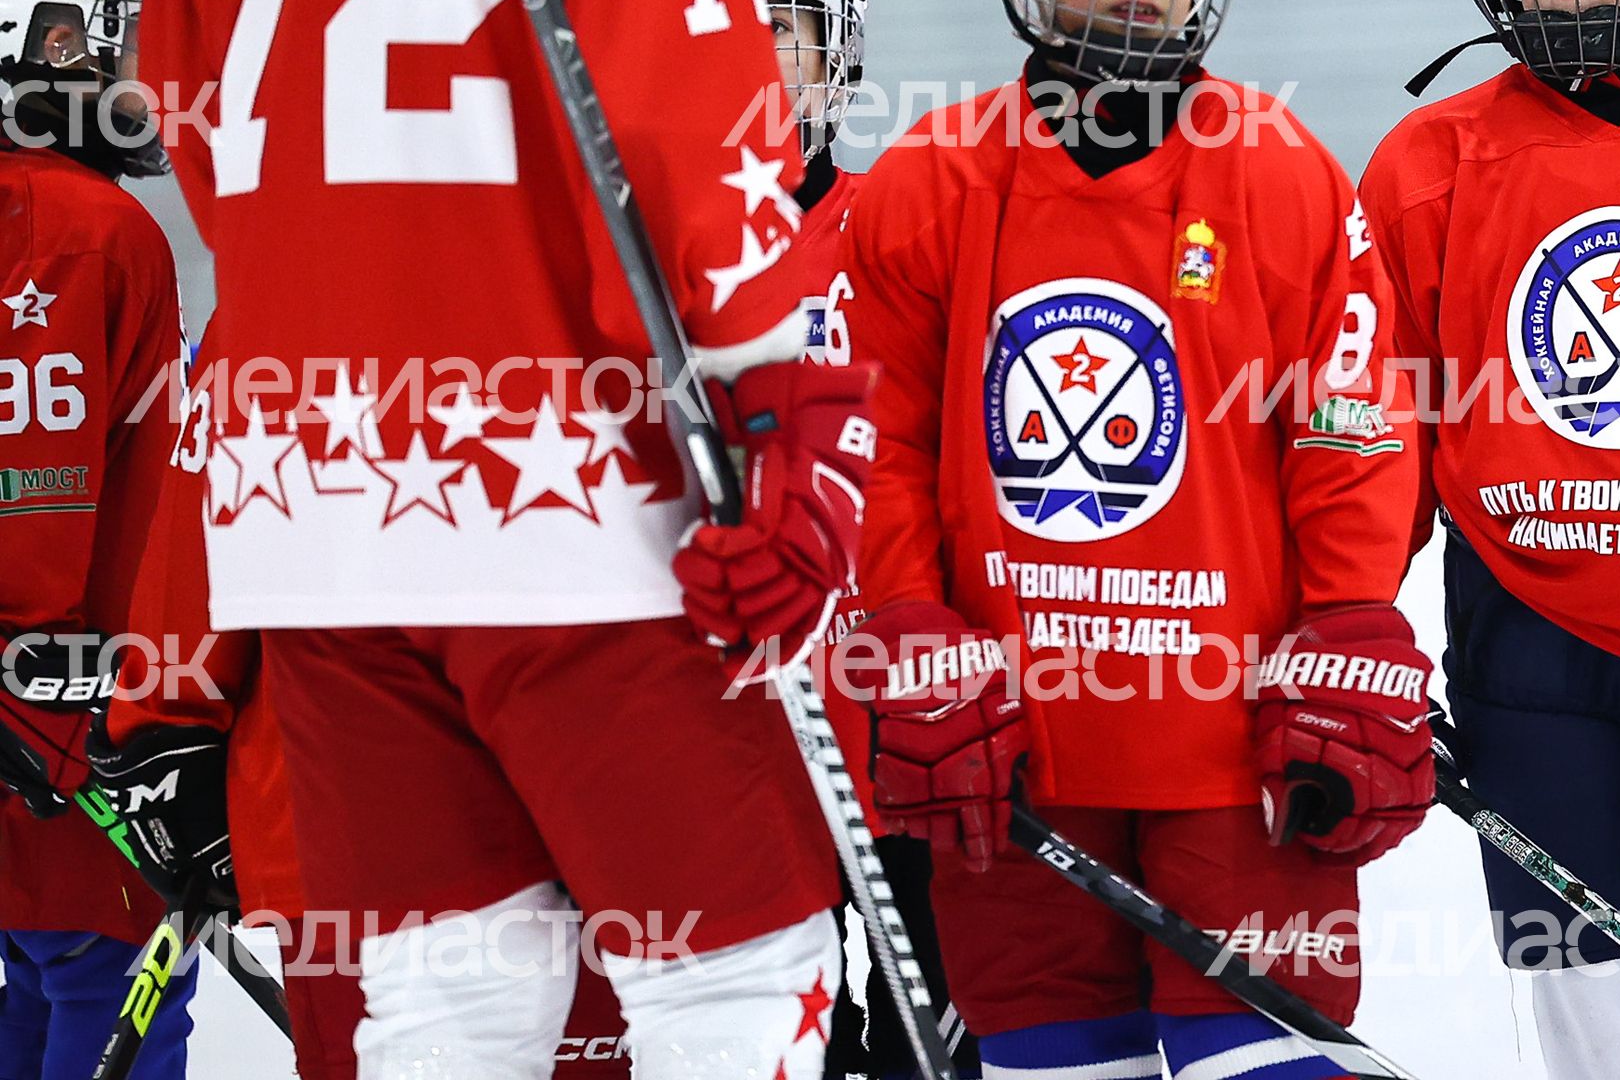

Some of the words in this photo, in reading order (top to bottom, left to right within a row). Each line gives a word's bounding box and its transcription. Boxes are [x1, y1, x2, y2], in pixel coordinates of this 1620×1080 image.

[21, 293, 40, 319] 2
[1529, 276, 1556, 383] ХОККЕЙНАЯ
[1566, 331, 1597, 364] А
[1032, 304, 1135, 335] АКАДЕМИЯ
[1151, 357, 1177, 458] ФЕТИСОВА
[1069, 352, 1091, 383] 2
[1017, 409, 1049, 445] А
[20, 465, 89, 491] МОСТ
[1479, 481, 1536, 516] ПУТЬ
[1537, 479, 1558, 512] К
[1113, 616, 1202, 656] ЗДЕСЬ
[22, 668, 121, 702] BAU
[887, 637, 1011, 700] WARR
[1256, 651, 1427, 703] WARRIOR
